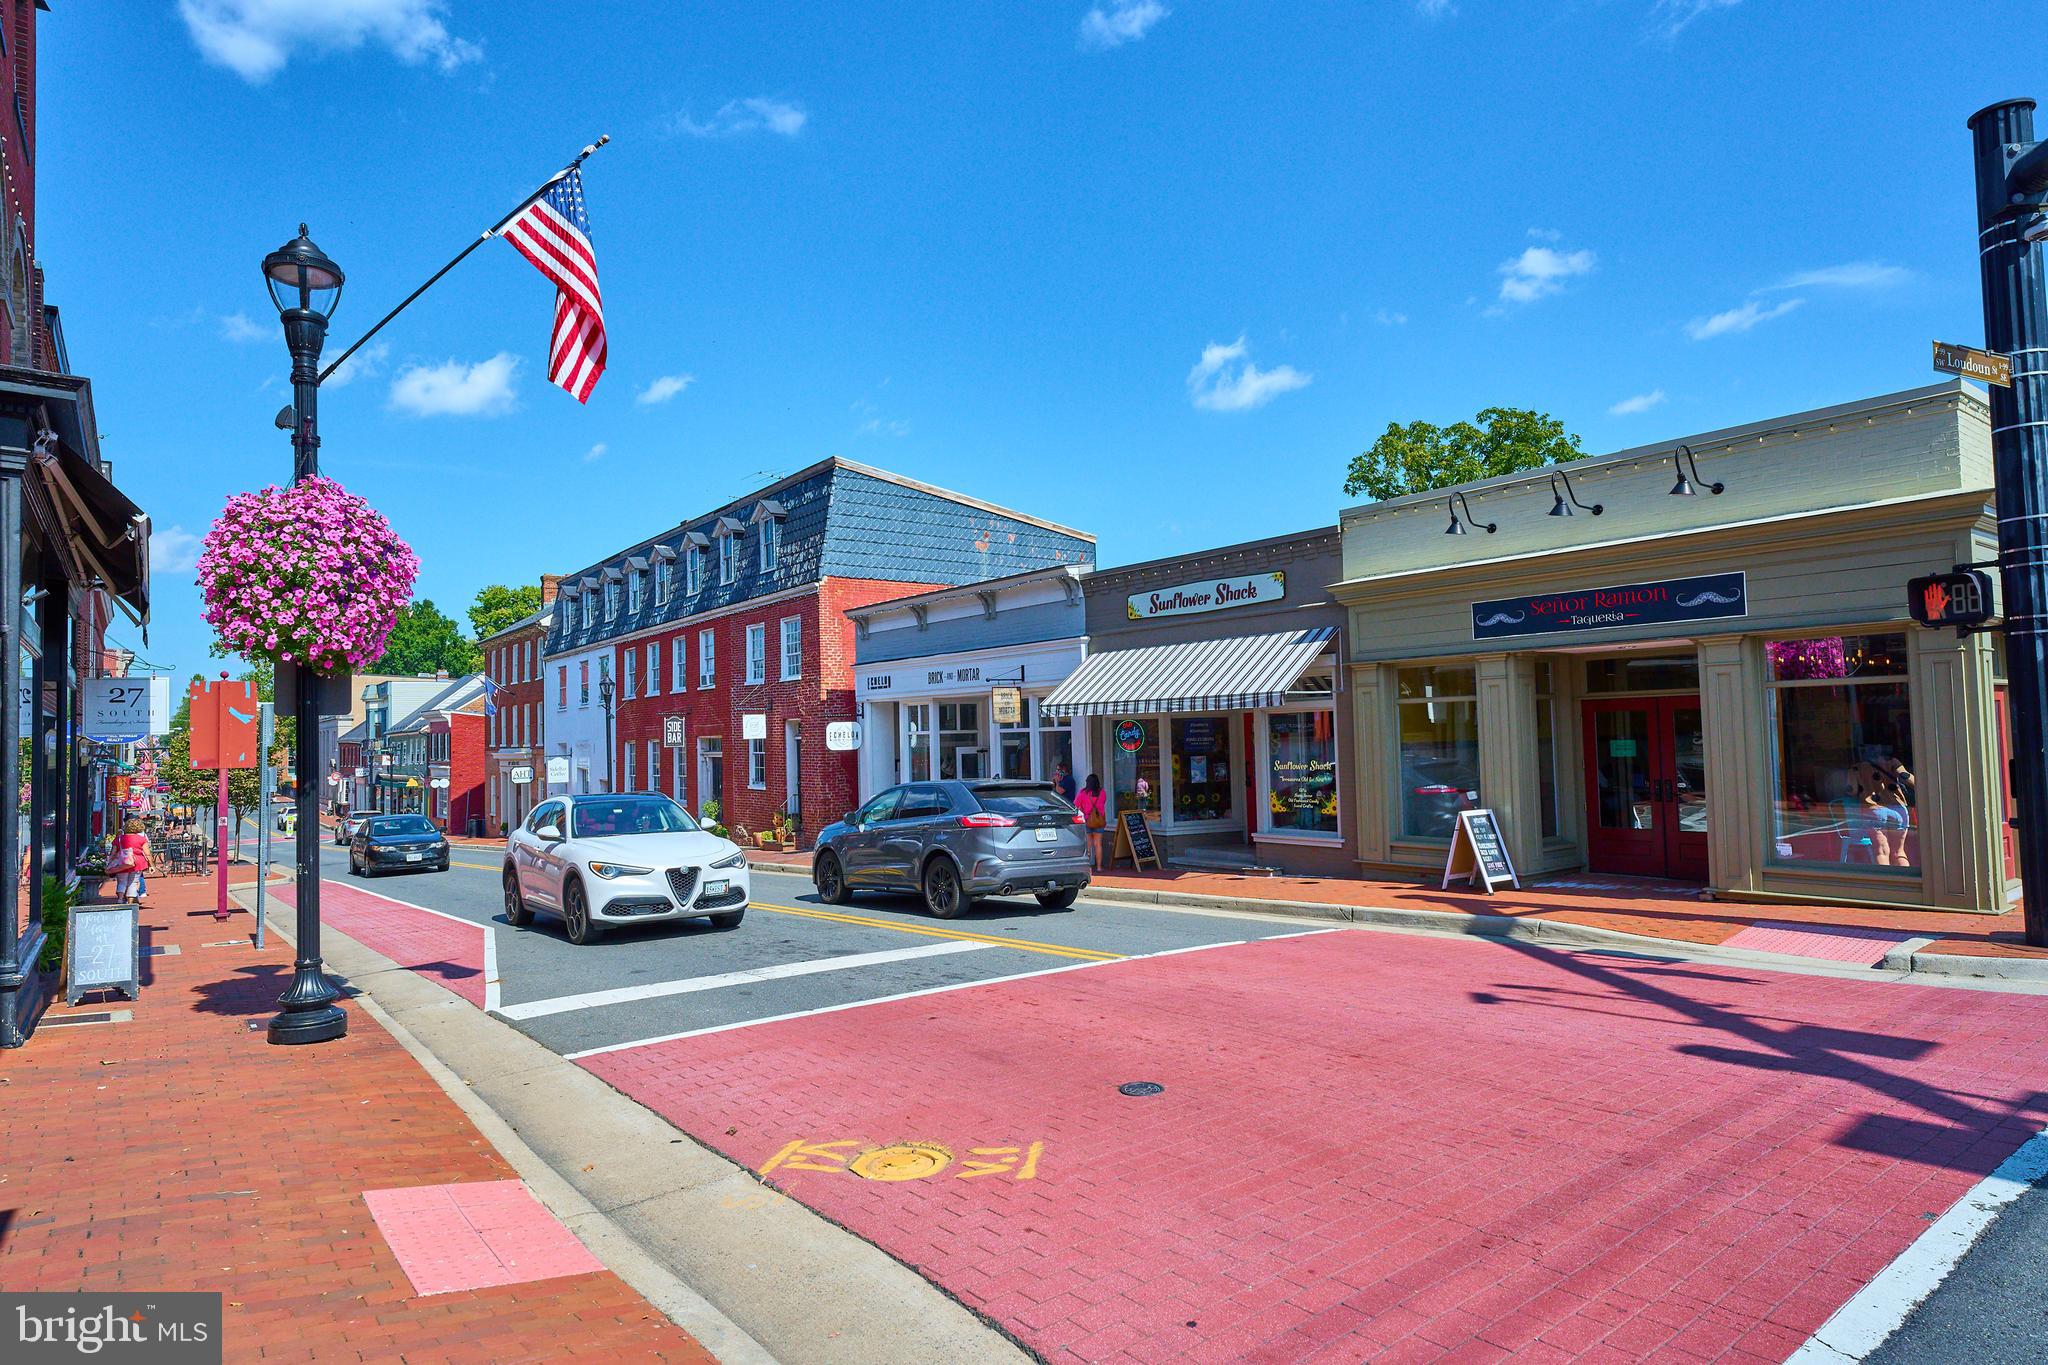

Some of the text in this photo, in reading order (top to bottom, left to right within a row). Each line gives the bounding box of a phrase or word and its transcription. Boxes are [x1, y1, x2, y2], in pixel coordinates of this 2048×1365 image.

[1947, 352, 1991, 375] Loudoun
[2000, 373, 2008, 382] SE
[1149, 581, 1258, 615] Sunflower Shack
[1530, 586, 1667, 616] Señor Ramon
[1570, 610, 1624, 626] Taqueria
[927, 670, 944, 685] BRICK
[957, 667, 980, 682] MORTAR
[108, 687, 145, 708] 27
[97, 709, 155, 717] SOUTH
[667, 721, 682, 732] SIDE
[667, 732, 682, 744] BAR
[1274, 760, 1331, 771] Sunflower Shack
[91, 943, 116, 969] 27
